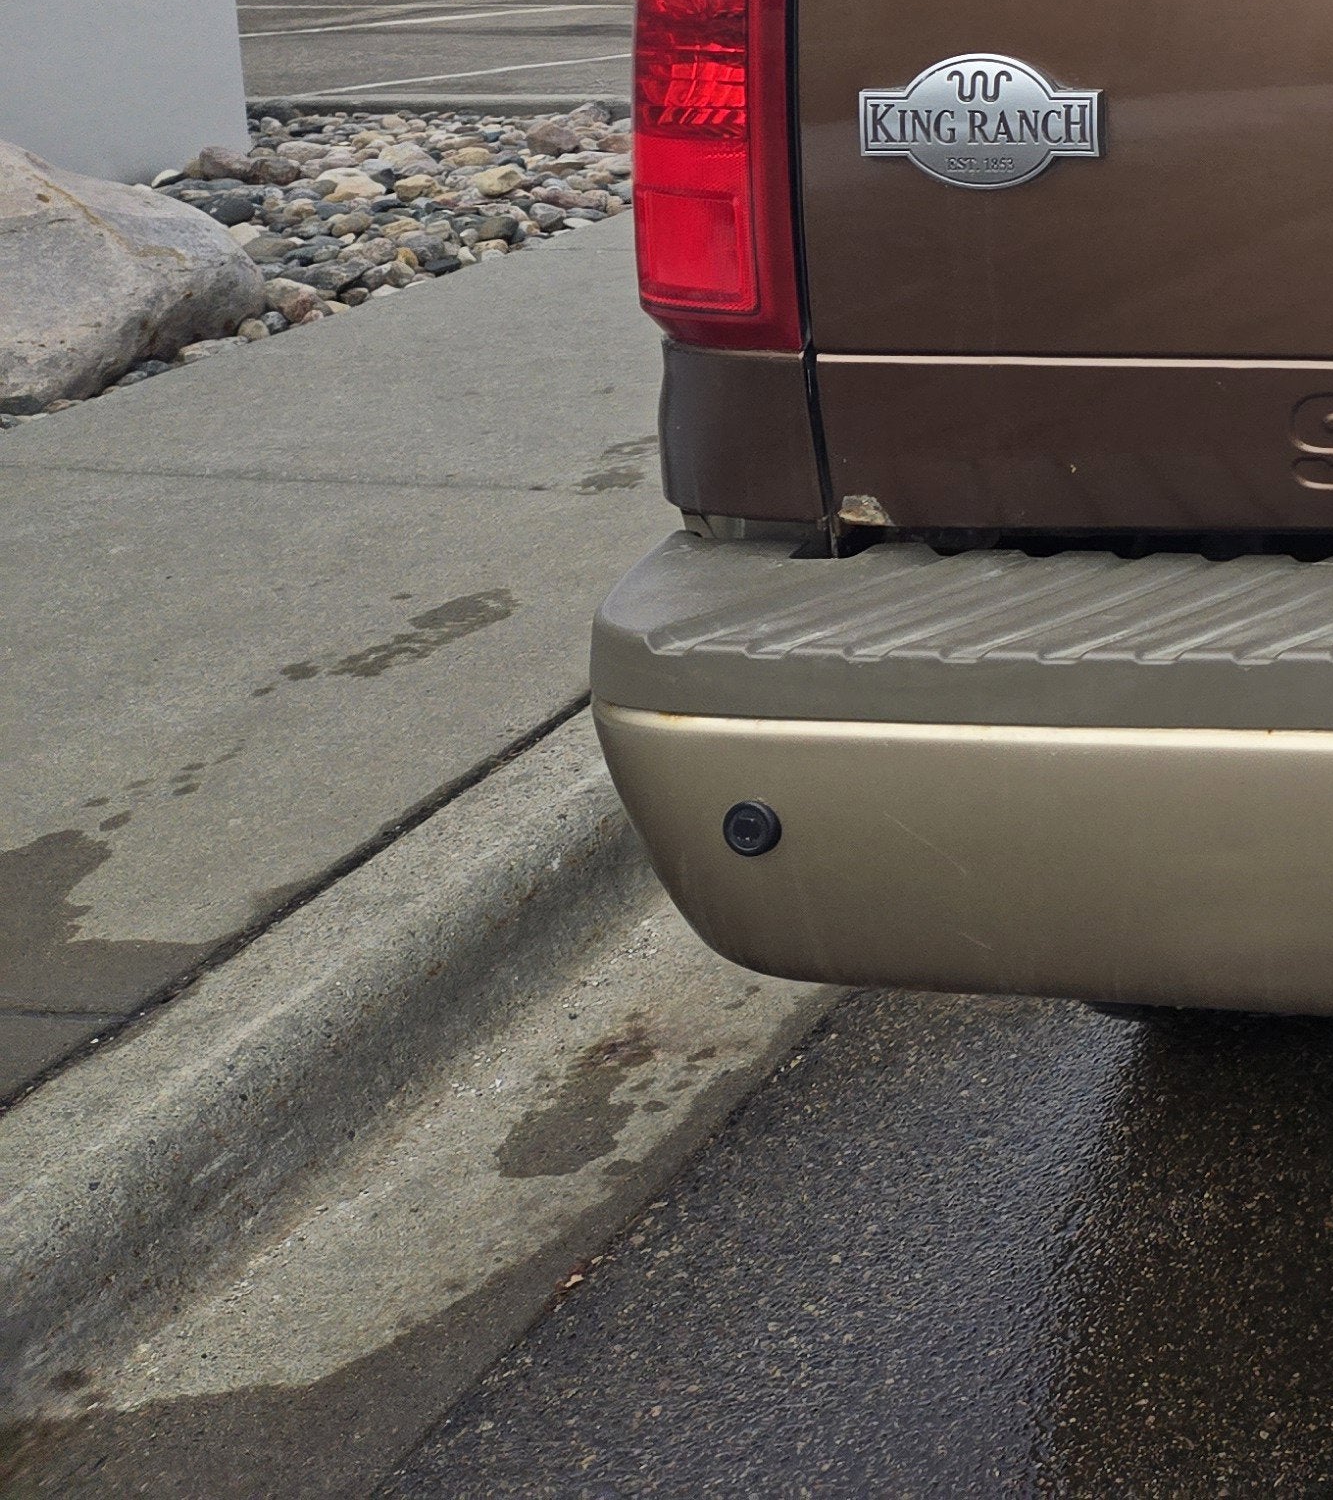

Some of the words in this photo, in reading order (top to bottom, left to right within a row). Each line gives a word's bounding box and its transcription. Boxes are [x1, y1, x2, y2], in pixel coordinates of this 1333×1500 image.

[869, 103, 957, 144] KING
[967, 103, 1090, 144] RANCH
[946, 156, 981, 173] EST.
[983, 156, 1015, 173] 1853
